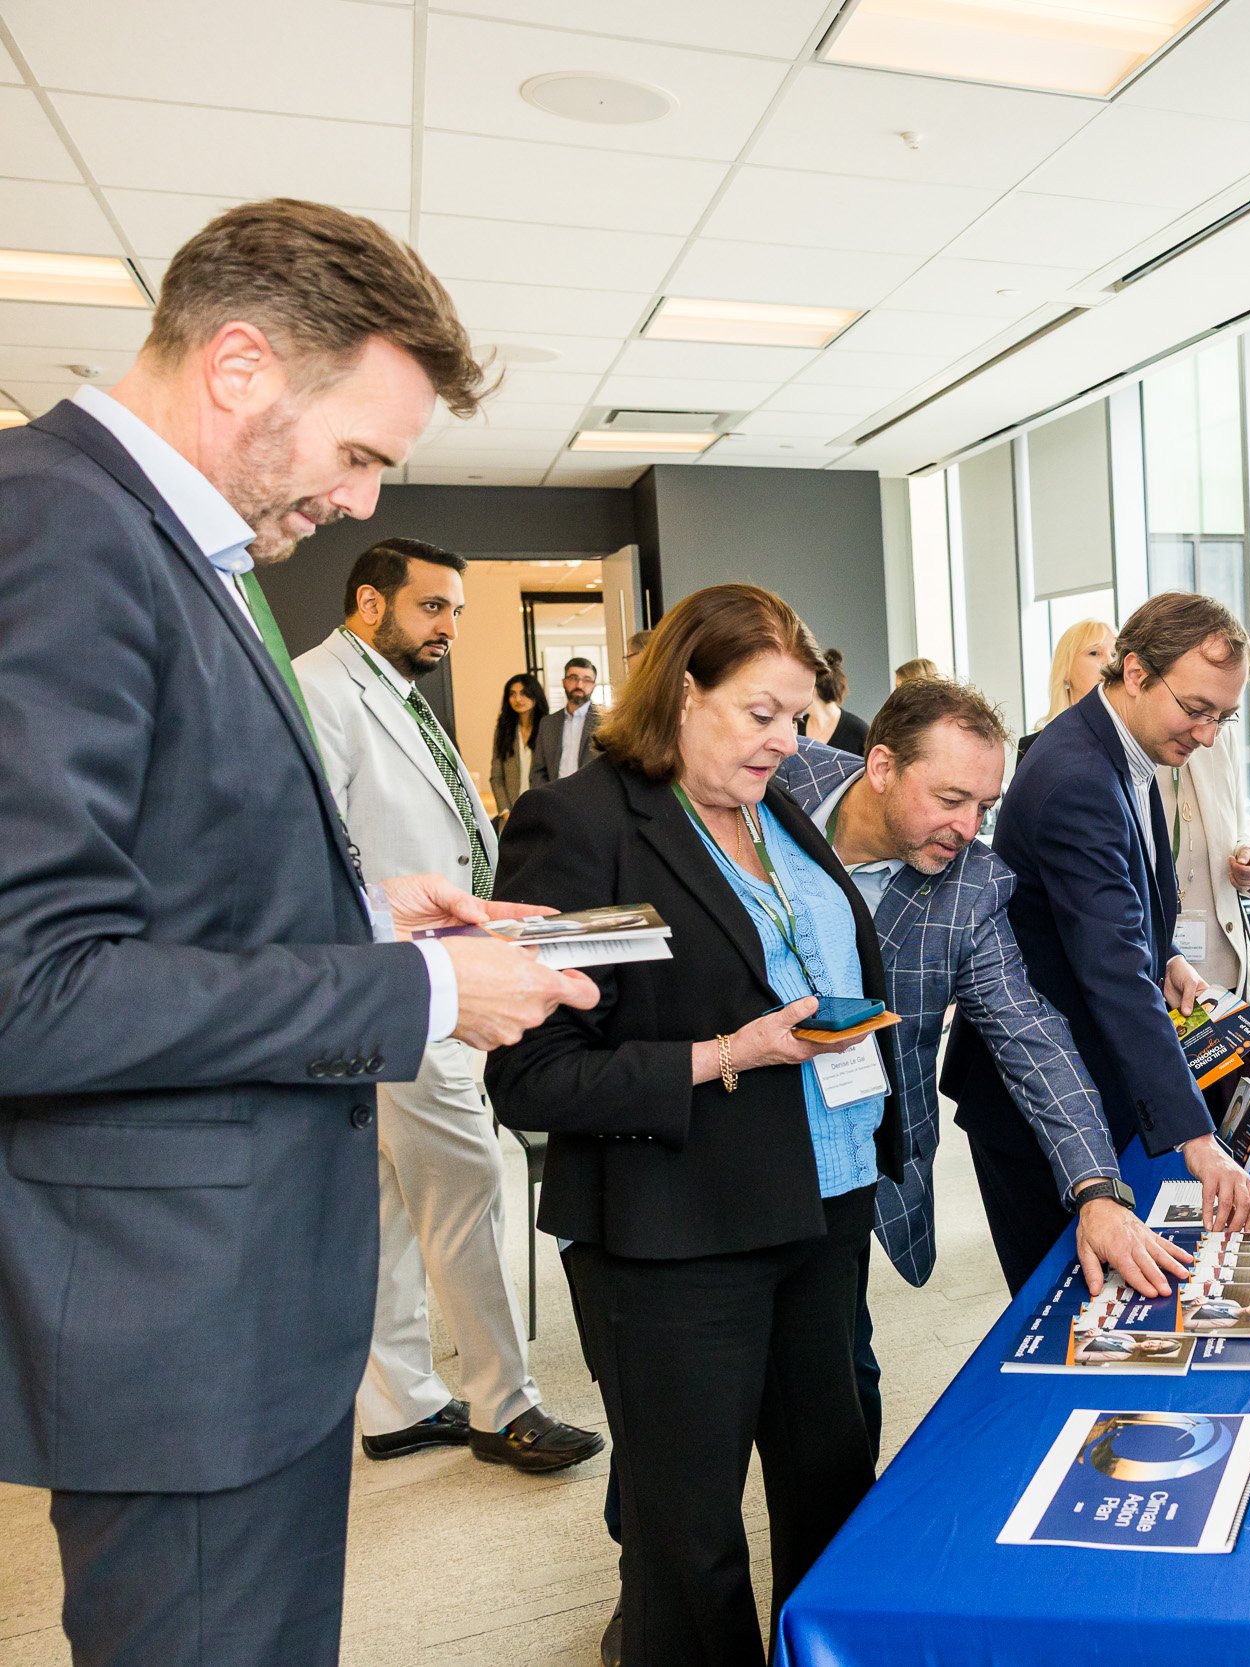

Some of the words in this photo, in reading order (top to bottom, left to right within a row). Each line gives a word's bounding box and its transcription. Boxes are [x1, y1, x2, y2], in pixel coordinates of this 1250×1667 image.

[831, 1060, 849, 1070] Denise
[1194, 1046, 1228, 1070] BUILDING
[1093, 1496, 1121, 1521] Plan
[1114, 1493, 1145, 1527] Action
[1136, 1490, 1169, 1532] Climate
